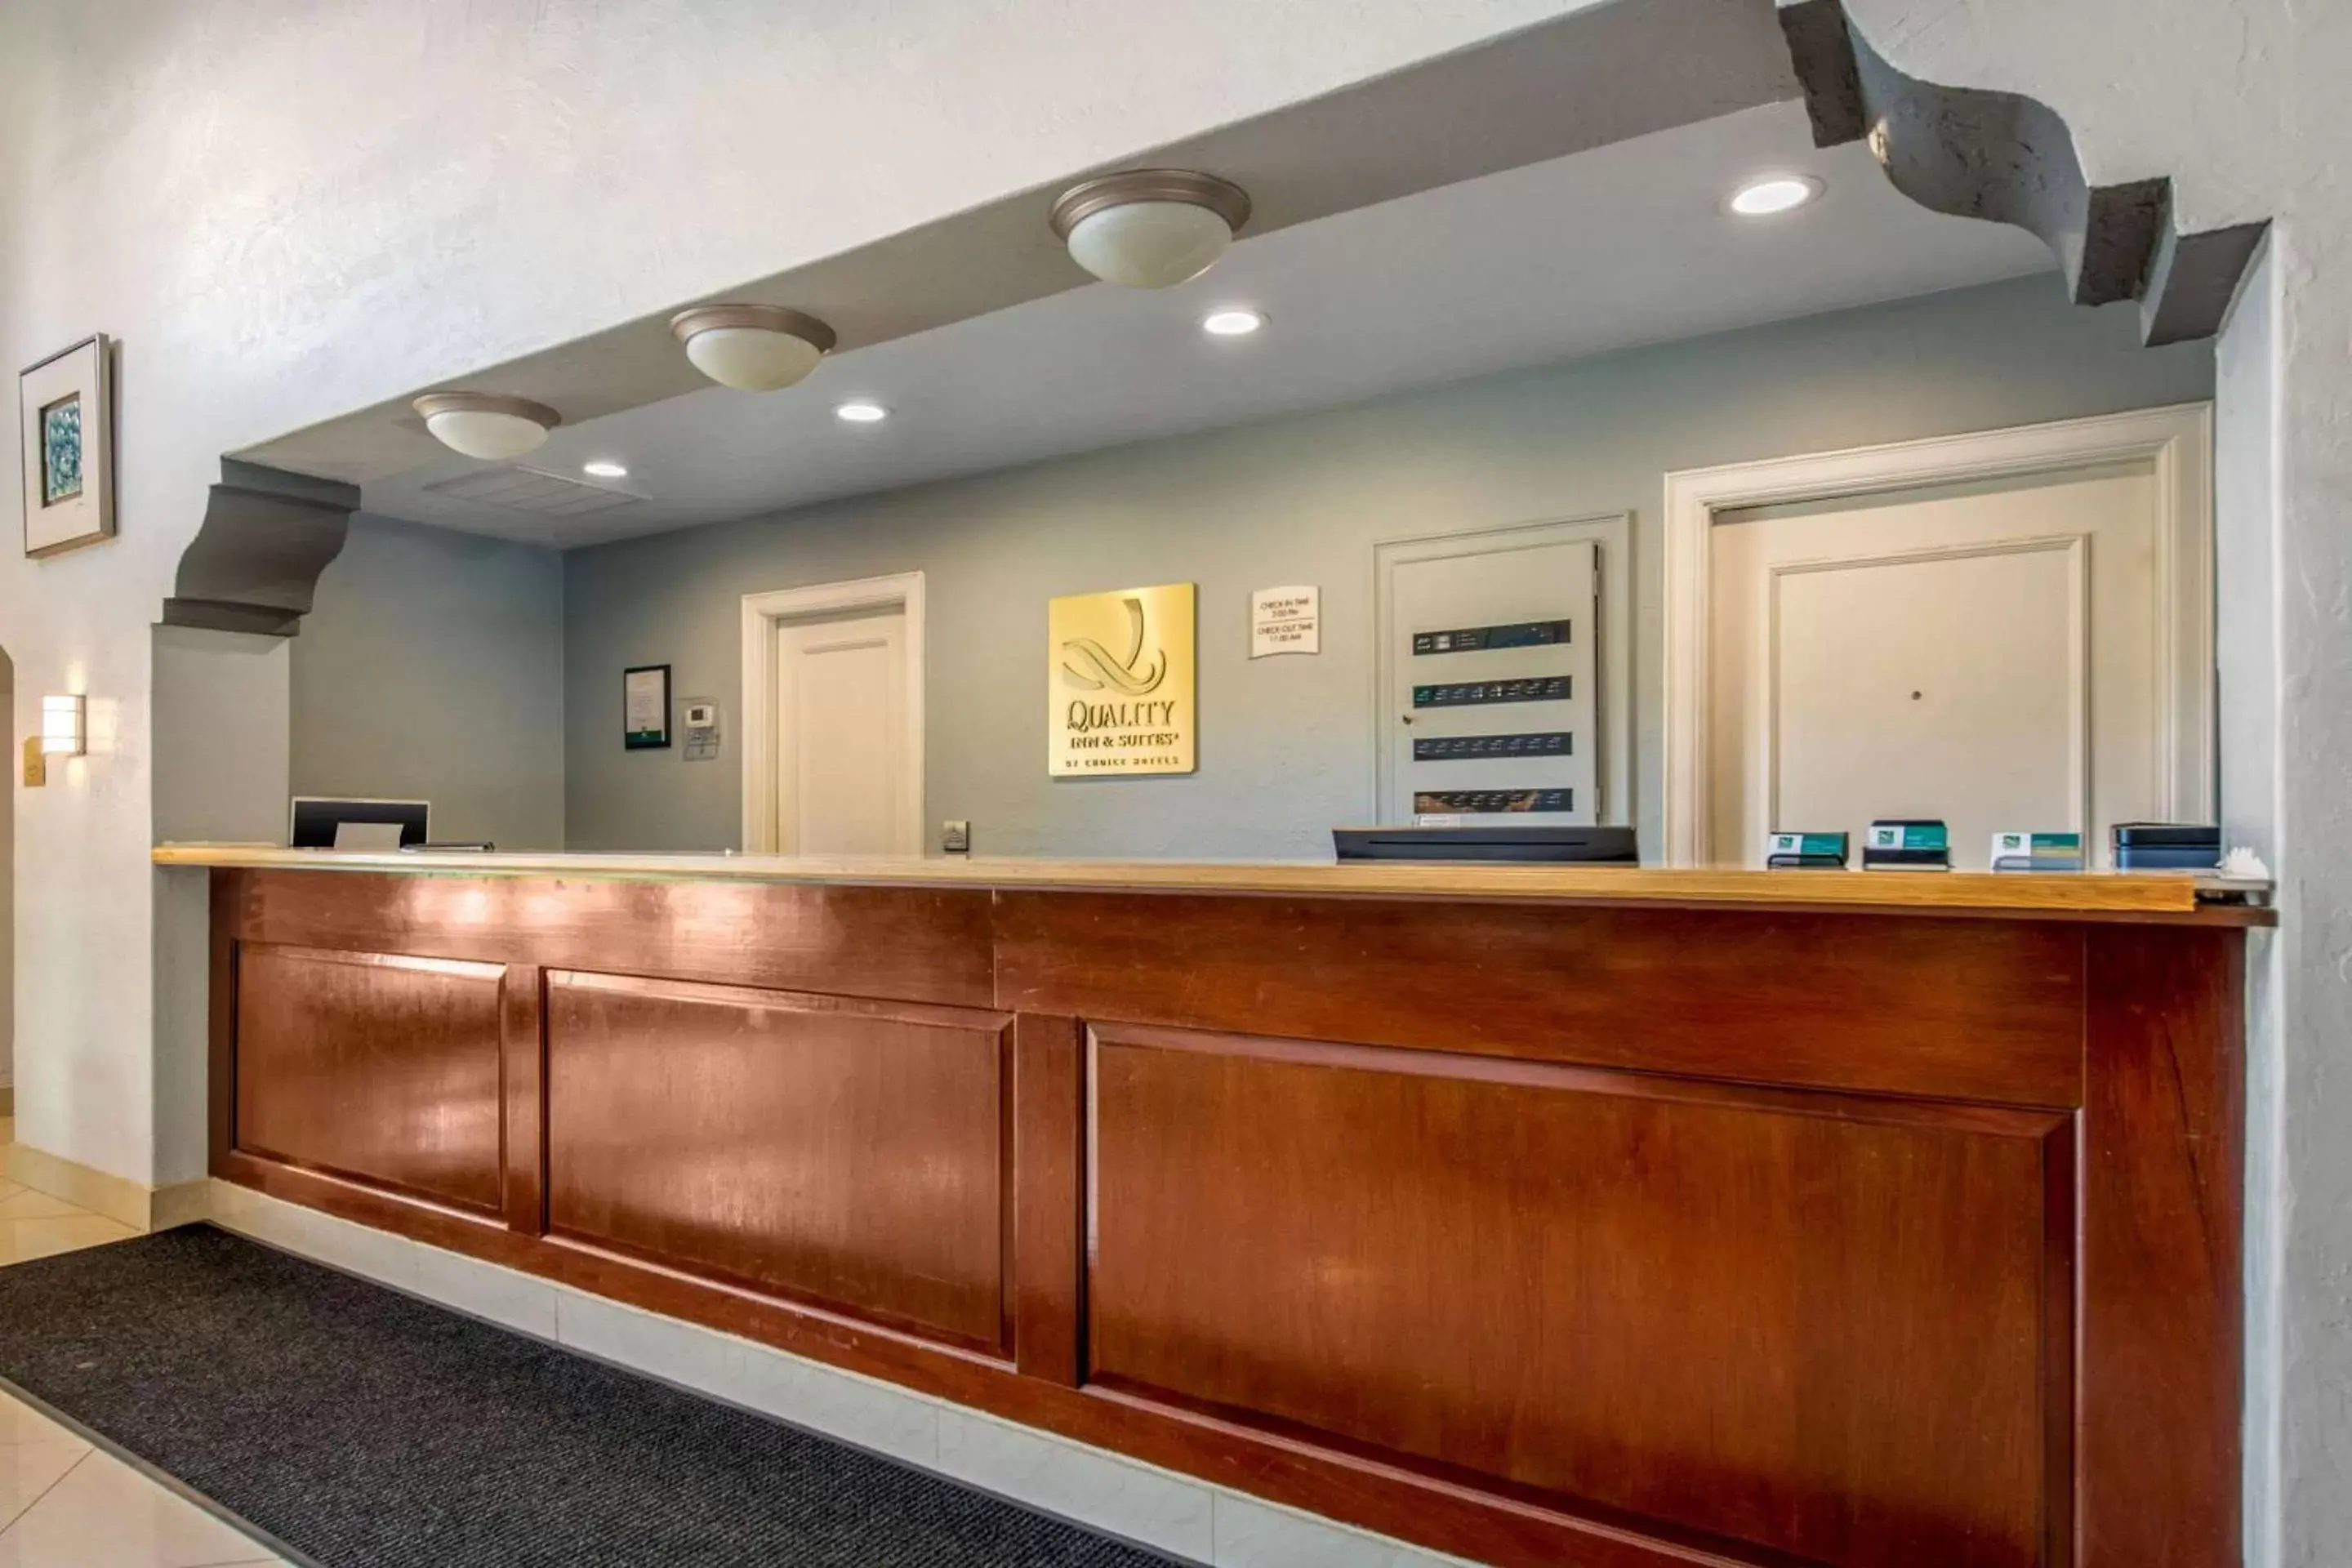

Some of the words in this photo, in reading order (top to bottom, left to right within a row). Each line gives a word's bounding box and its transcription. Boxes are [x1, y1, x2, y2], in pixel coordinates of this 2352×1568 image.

[1259, 601, 1283, 609] CHECK
[1257, 626, 1279, 635] CHECK
[1282, 625, 1296, 633] OUT
[1067, 700, 1175, 733] QUALITY
[1071, 736, 1098, 749] INN
[1102, 736, 1114, 747] &
[1085, 758, 1126, 767] CHOICE
[1134, 756, 1179, 766] HOTELS
